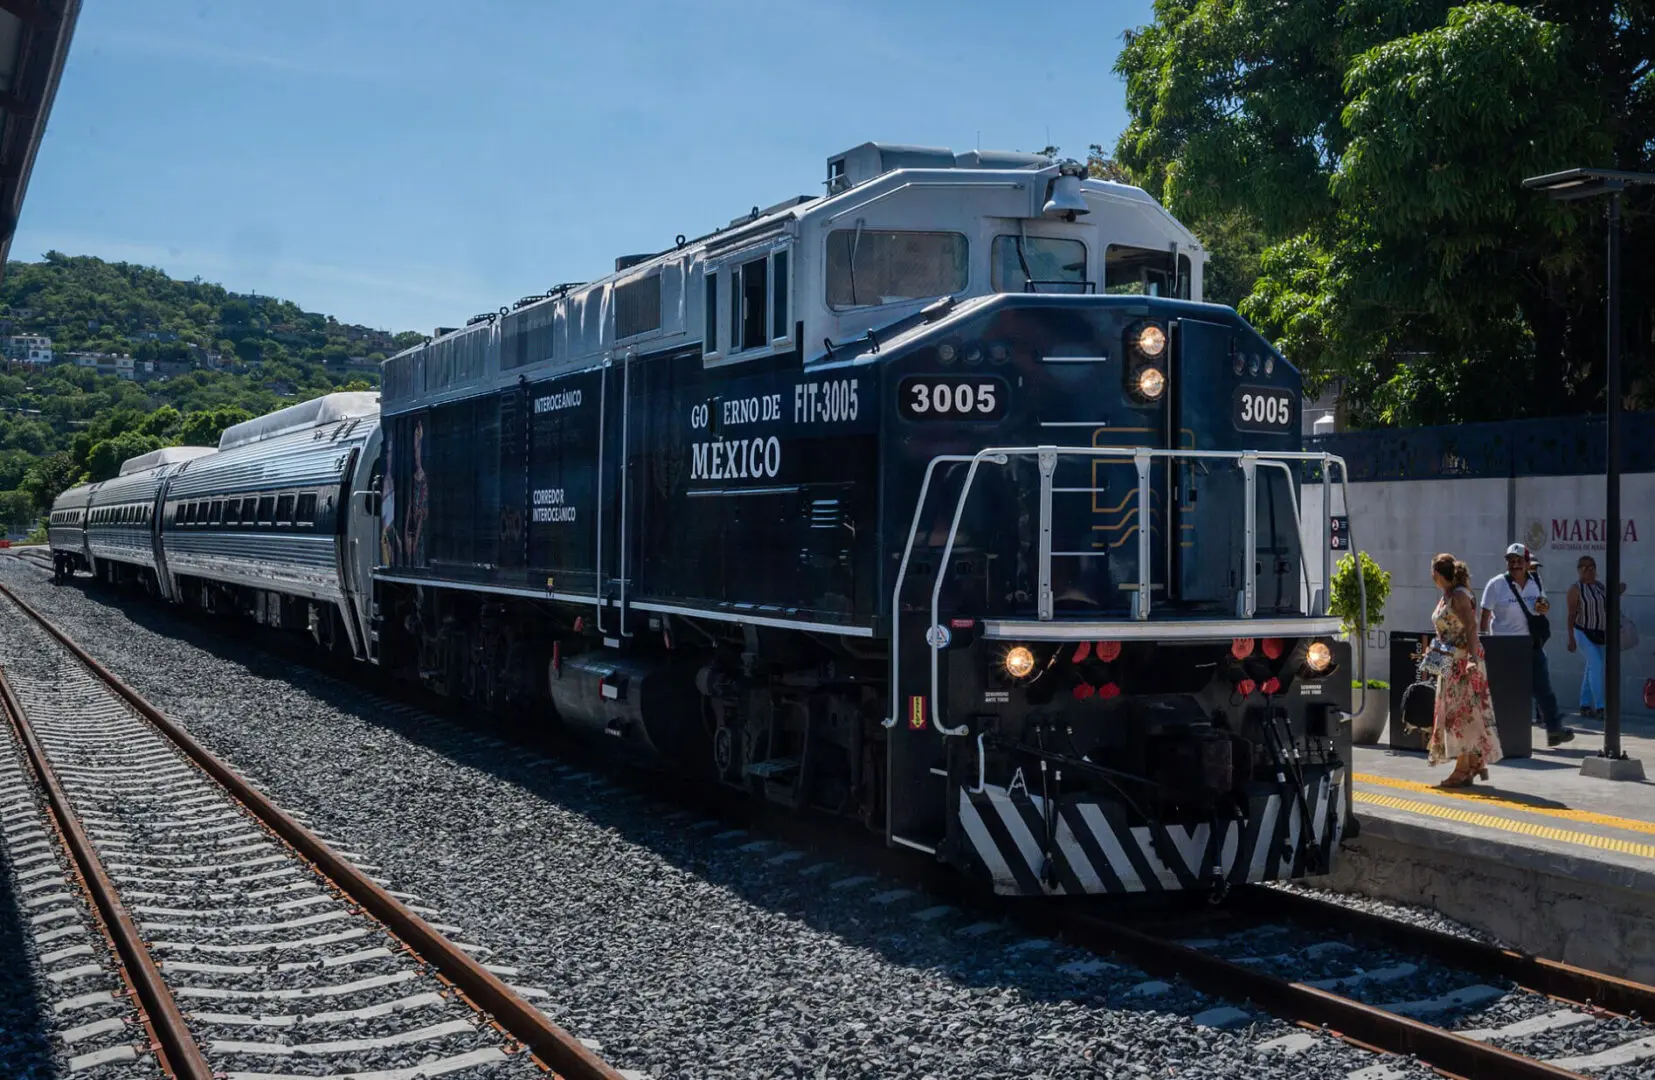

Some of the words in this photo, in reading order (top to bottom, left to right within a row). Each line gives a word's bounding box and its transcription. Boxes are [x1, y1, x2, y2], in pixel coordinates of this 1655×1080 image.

[534, 388, 582, 413] INTEROCEÁNICO
[691, 397, 759, 429] GOERNO
[762, 394, 781, 420] DE
[795, 378, 858, 423] FIT-3005
[911, 383, 996, 413] 3005
[1241, 394, 1289, 424] 3005
[690, 435, 781, 480] MÉXICO
[533, 488, 564, 505] CORREDOR
[1552, 519, 1639, 542] MARIA
